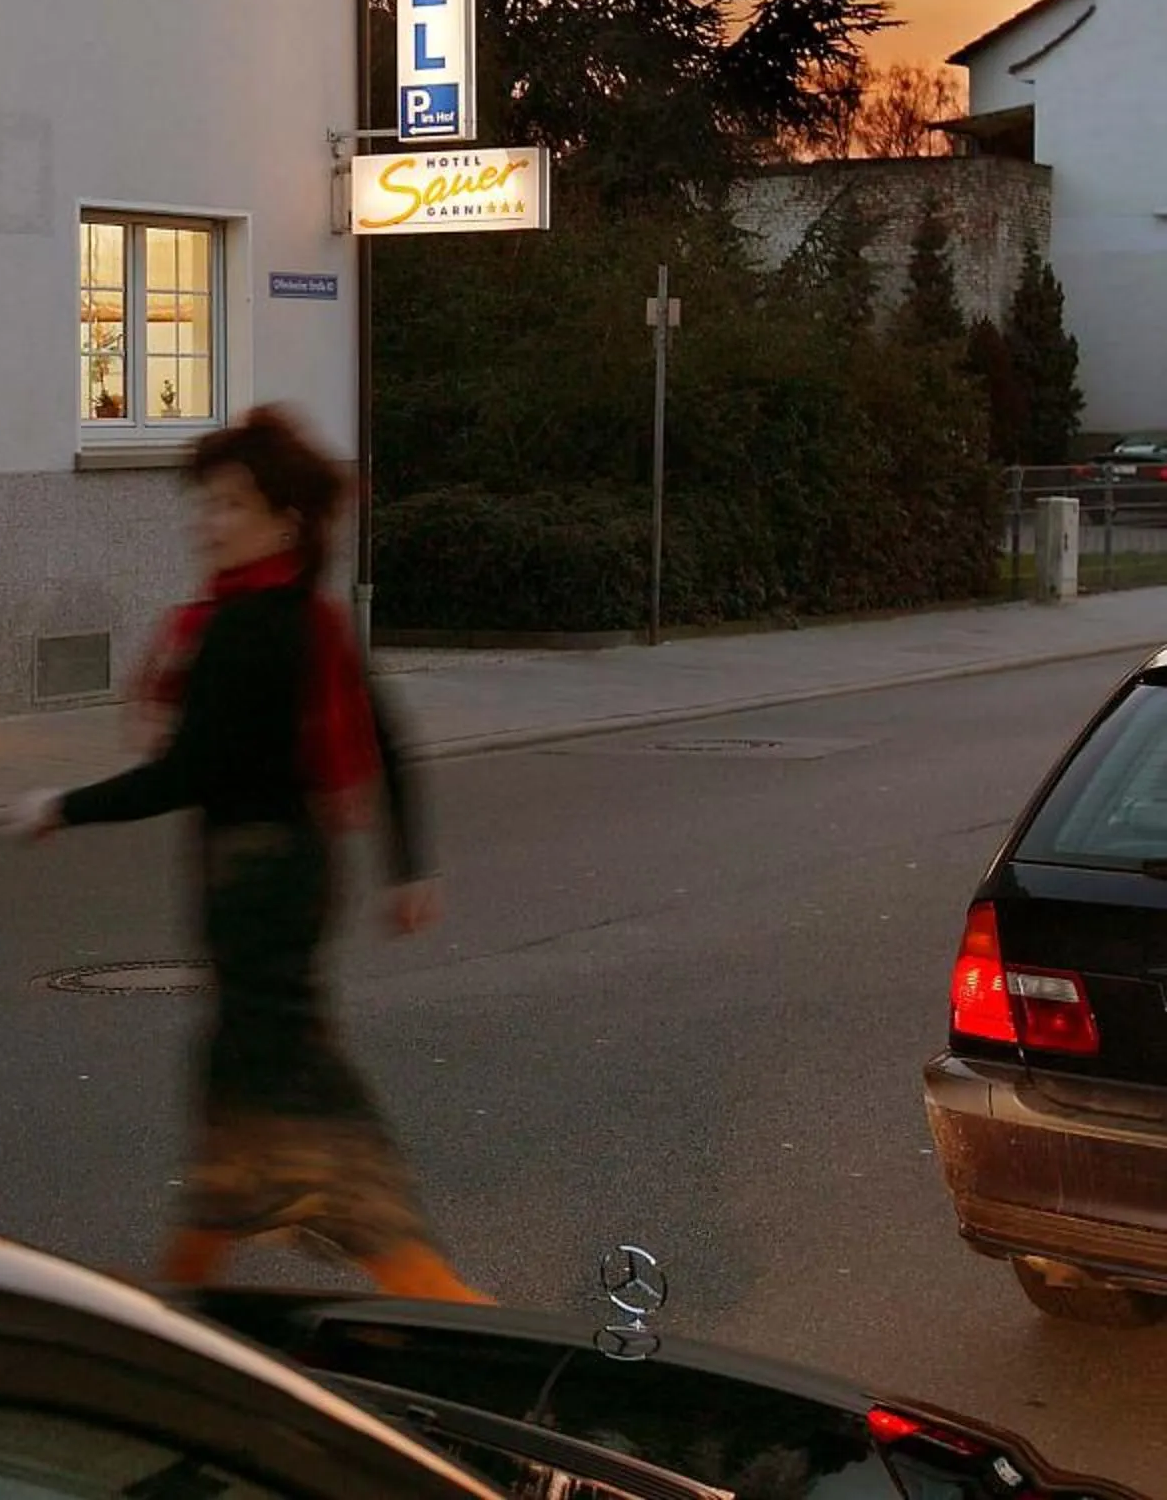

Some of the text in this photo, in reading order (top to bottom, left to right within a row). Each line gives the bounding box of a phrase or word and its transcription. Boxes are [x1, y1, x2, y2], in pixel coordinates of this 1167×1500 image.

[407, 89, 431, 125] P
[426, 156, 482, 168] HOTEL
[359, 157, 530, 228] Sauer
[426, 205, 482, 216] GARNI
